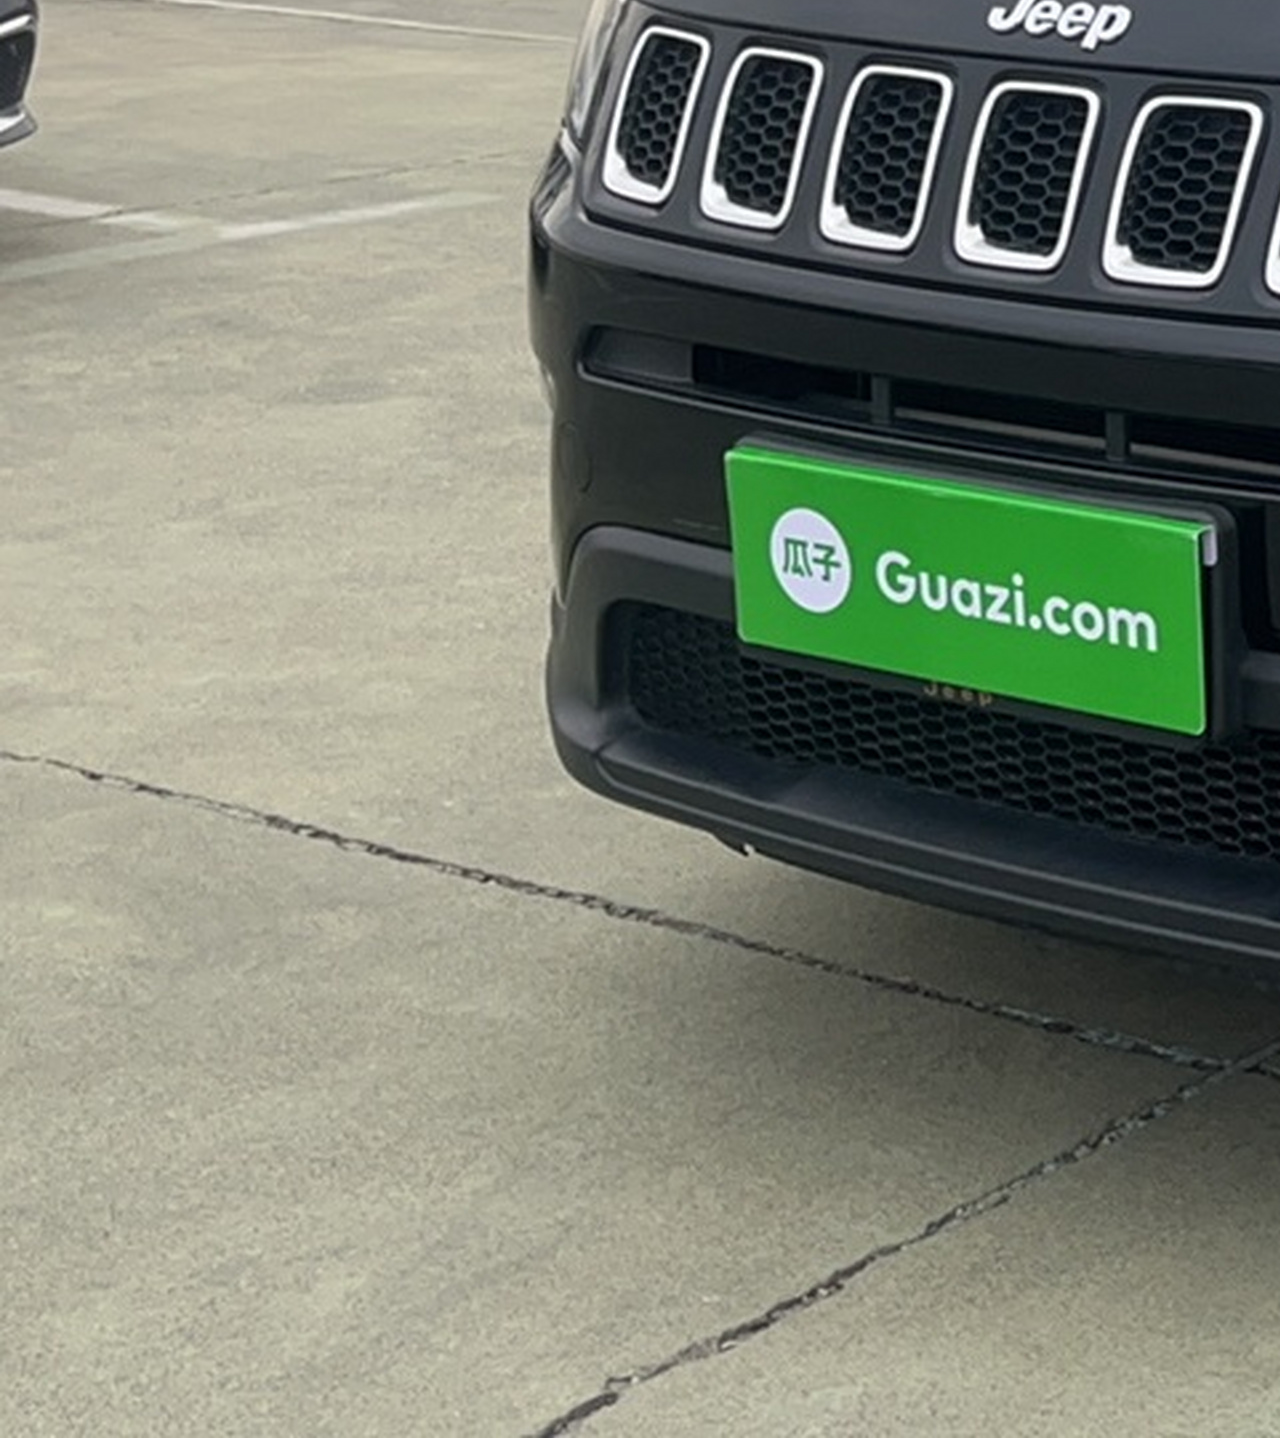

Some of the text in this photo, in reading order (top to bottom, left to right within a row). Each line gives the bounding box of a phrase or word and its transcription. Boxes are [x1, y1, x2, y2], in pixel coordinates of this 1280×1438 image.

[781, 536, 842, 583] 瓜子
[875, 550, 1158, 652] Guazi.com
[922, 679, 993, 708] Jeep
